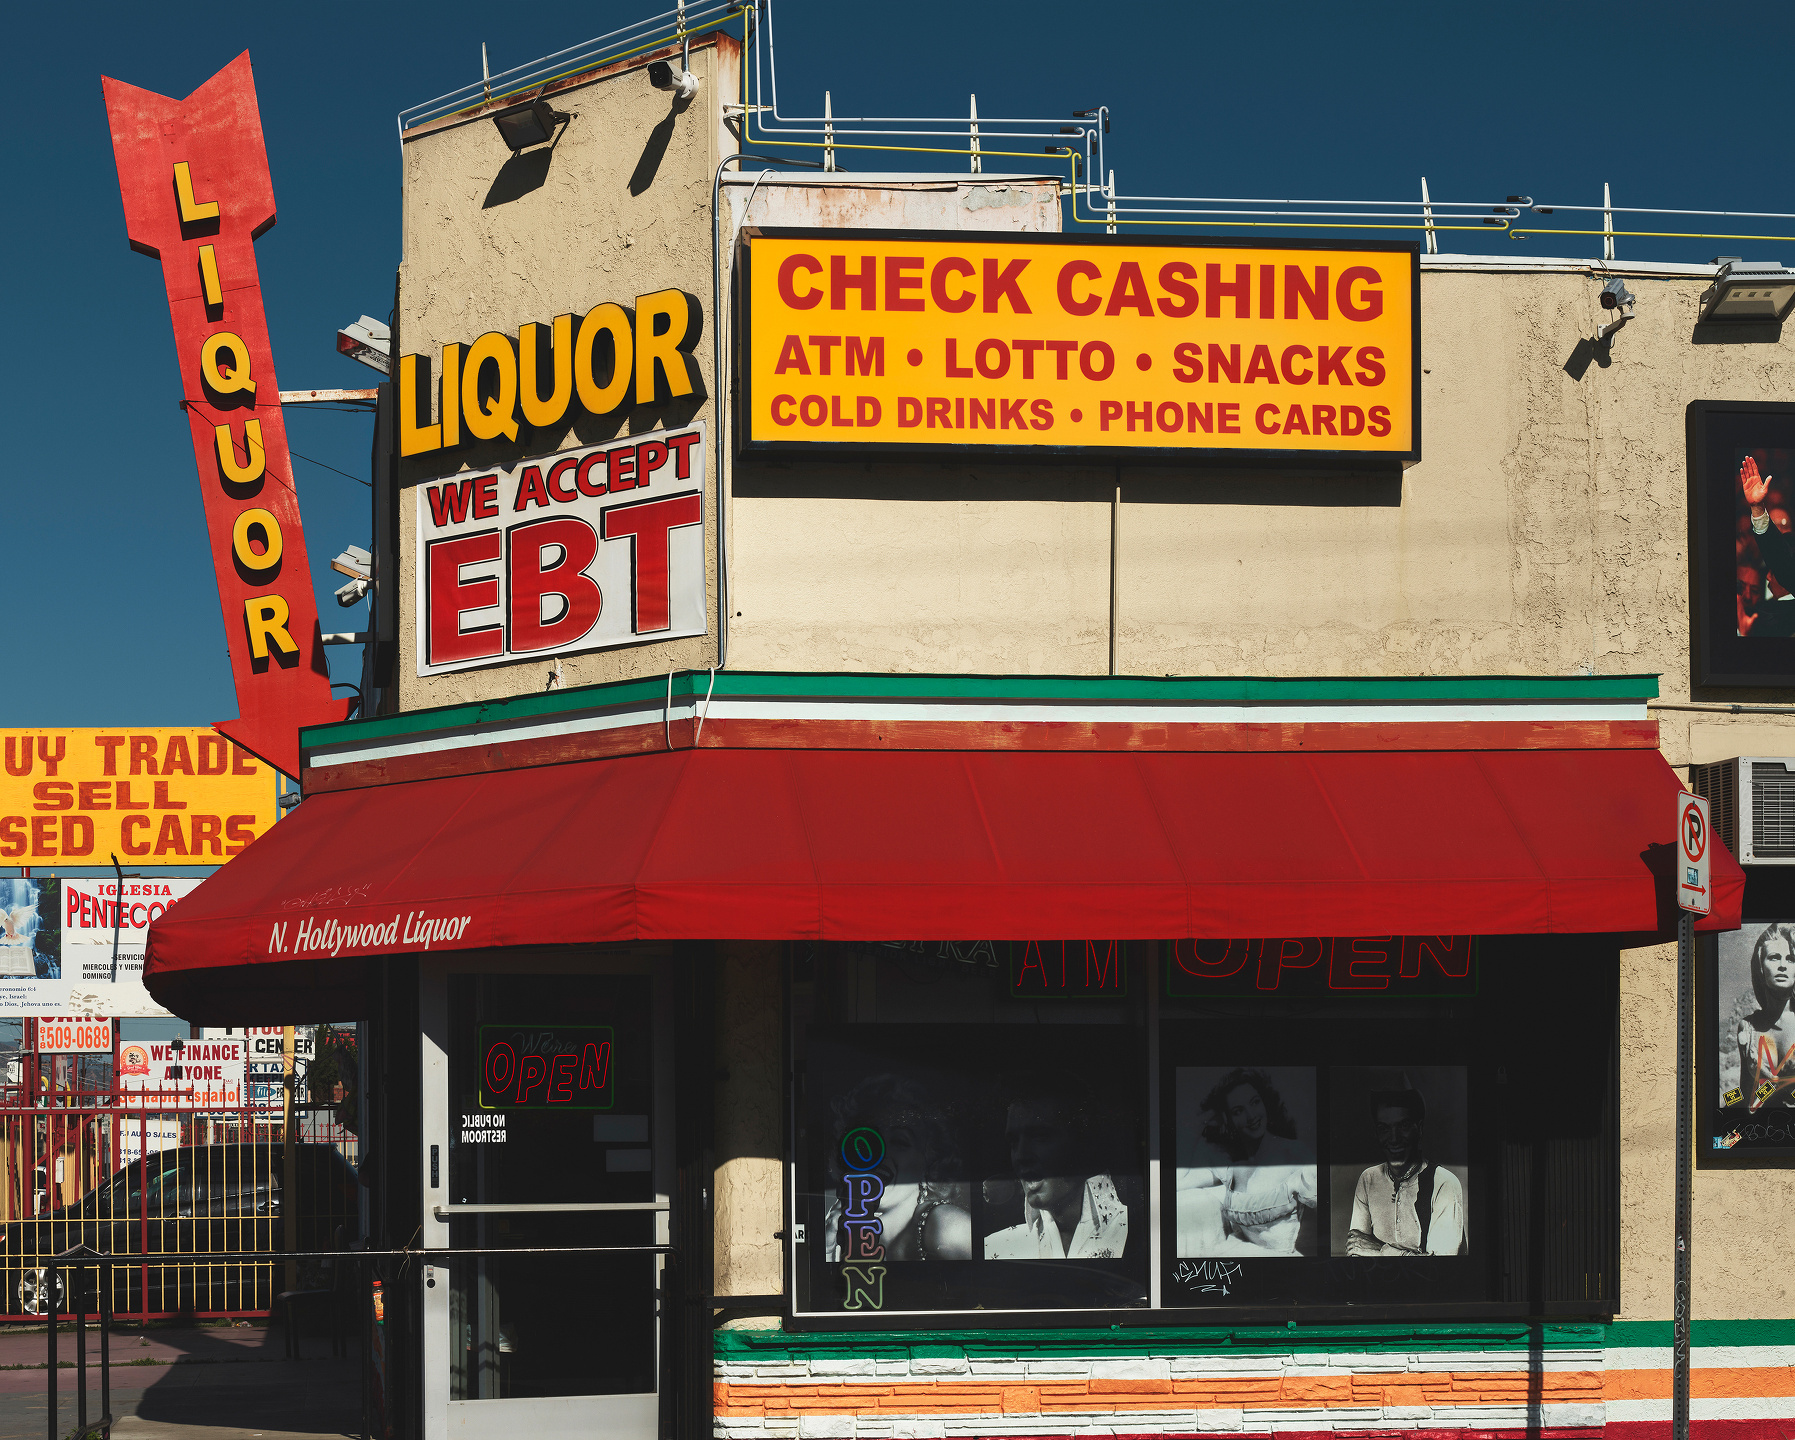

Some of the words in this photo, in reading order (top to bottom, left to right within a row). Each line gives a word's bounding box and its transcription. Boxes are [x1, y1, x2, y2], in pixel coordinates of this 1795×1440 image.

[777, 253, 1033, 314] CHECK
[1056, 259, 1384, 322] CASHING
[400, 288, 704, 458] LIQUOR
[774, 335, 885, 377] ATM
[945, 338, 1115, 382] LOTTO
[1172, 342, 1386, 387] SNACKS
[173, 161, 300, 674] LIQUOR
[770, 394, 882, 427] COLD
[897, 396, 1055, 431] DRINKS
[1100, 400, 1241, 434] PHONE
[1254, 403, 1392, 437] CARDS
[427, 474, 500, 527] WE
[513, 432, 701, 512] ACCEPT
[425, 490, 703, 667] EBT
[33, 781, 188, 811] SELL
[120, 814, 256, 856] CARS
[98, 884, 172, 896] IGLESIA
[268, 921, 289, 954] N.
[294, 915, 401, 957] Hollywood
[402, 910, 472, 950] Liquor
[82, 972, 112, 980] DOMINGO
[124, 963, 144, 971] VIERN
[1175, 935, 1473, 989] OPEN
[46, 1026, 110, 1049] 509-0689
[150, 1045, 174, 1061] WE
[178, 1045, 240, 1061] FINANCE
[485, 1041, 611, 1103] OPEN
[841, 1127, 887, 1310] OPEN
